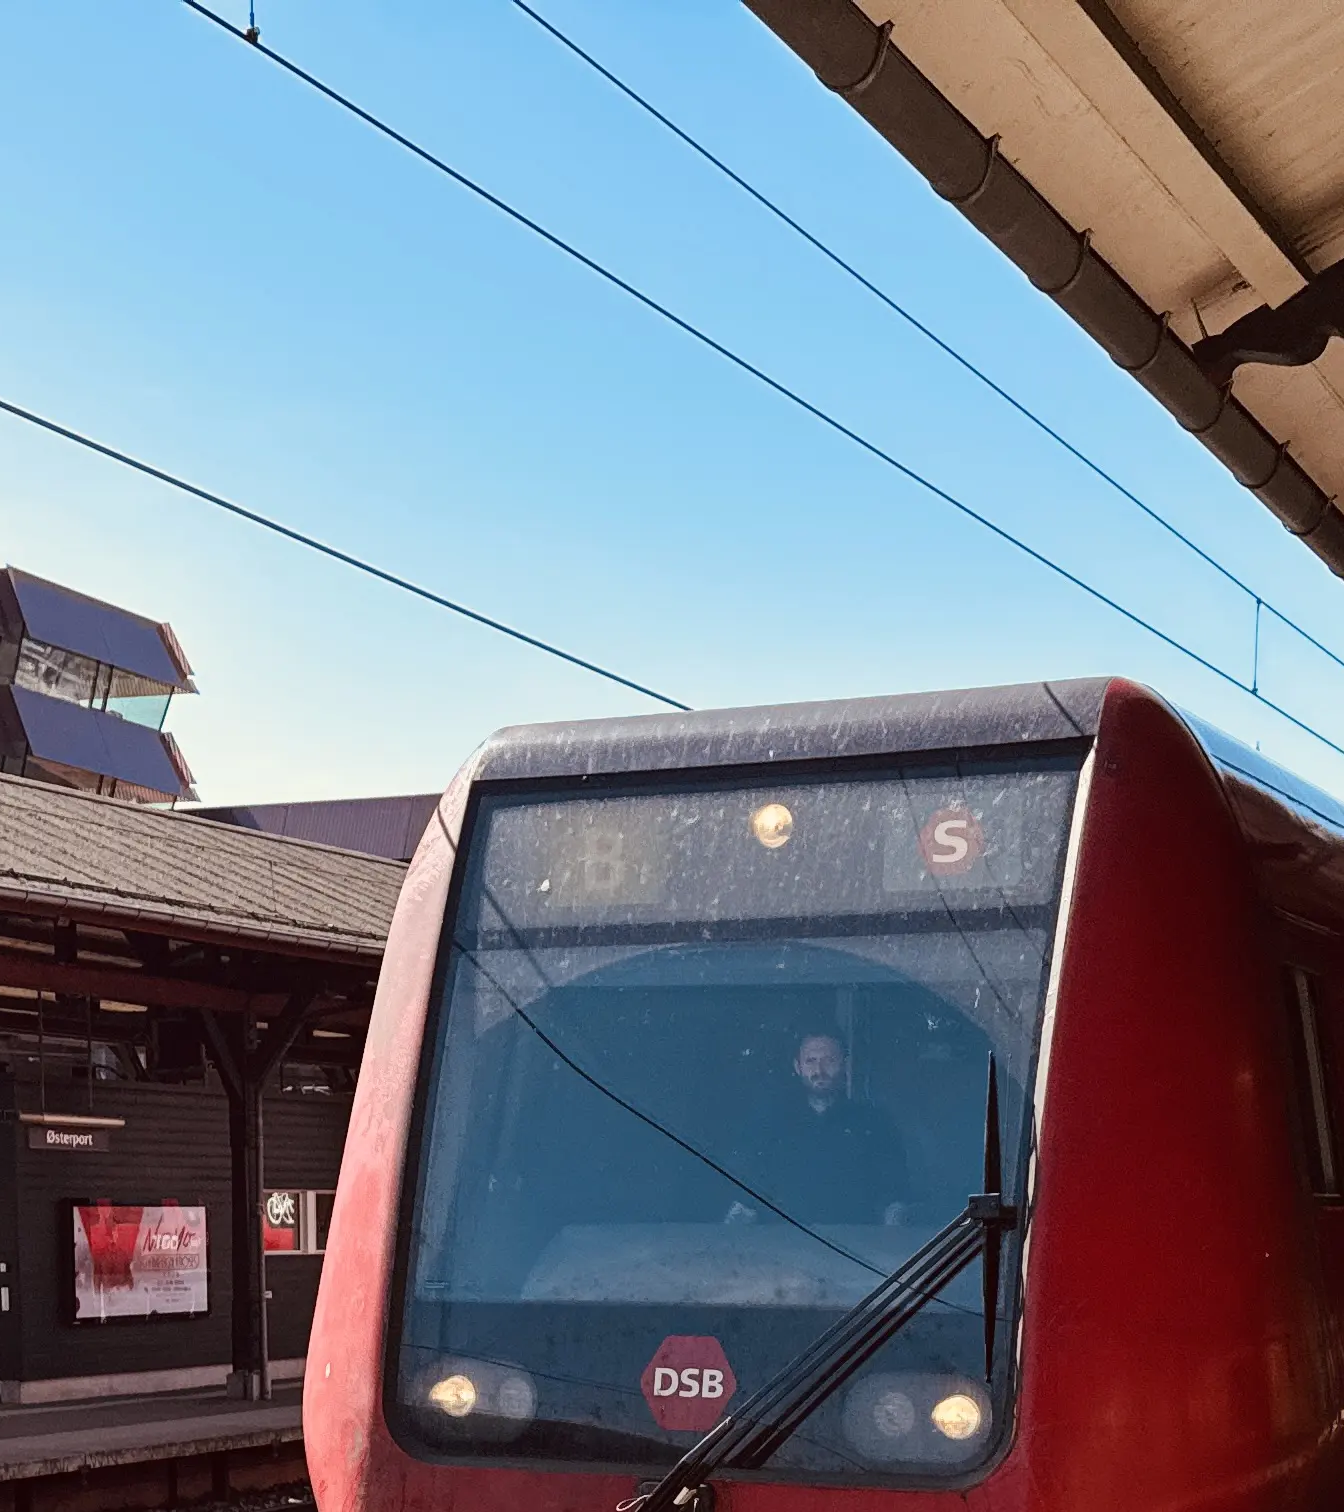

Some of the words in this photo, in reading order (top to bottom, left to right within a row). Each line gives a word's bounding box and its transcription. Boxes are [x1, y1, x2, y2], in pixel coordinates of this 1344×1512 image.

[932, 819, 969, 863] S
[46, 1129, 94, 1148] Østerport
[653, 1367, 724, 1398] DSB
